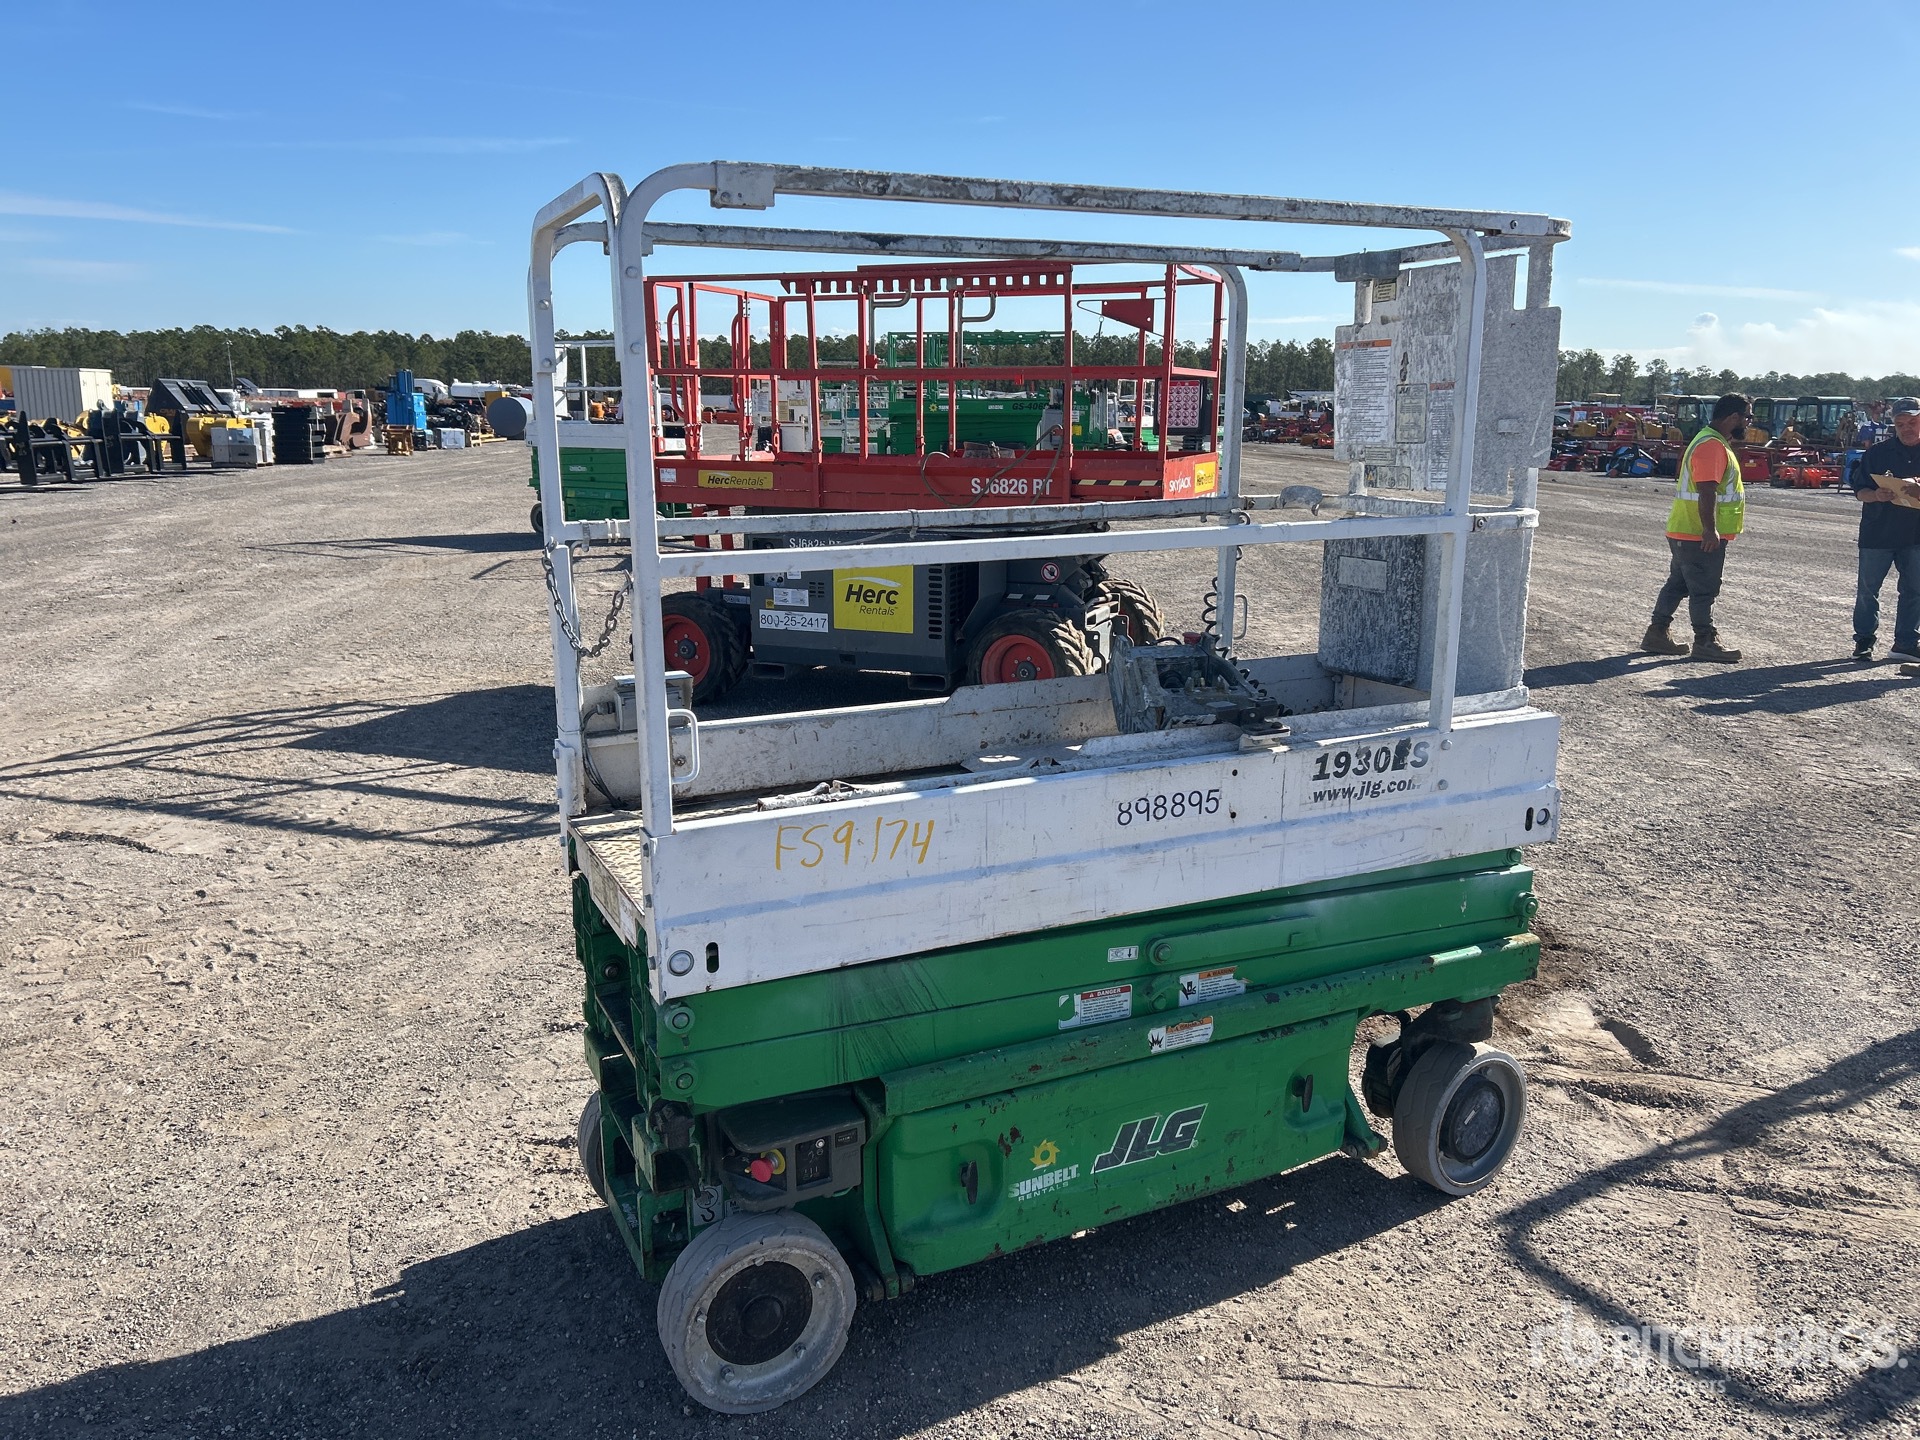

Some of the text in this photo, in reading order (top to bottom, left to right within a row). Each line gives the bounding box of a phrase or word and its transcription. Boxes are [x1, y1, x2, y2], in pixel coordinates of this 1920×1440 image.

[971, 478, 1053, 495] SJ6826 RT
[845, 584, 899, 605] Herc
[760, 614, 827, 628] 800-25-2417
[859, 605, 895, 616] Rentals
[1117, 789, 1220, 826] 898895
[1097, 988, 1121, 997] DANGER
[1090, 1103, 1208, 1174] JLG
[1008, 1164, 1078, 1198] SUNBELT
[1018, 1181, 1069, 1202] RENTALS
